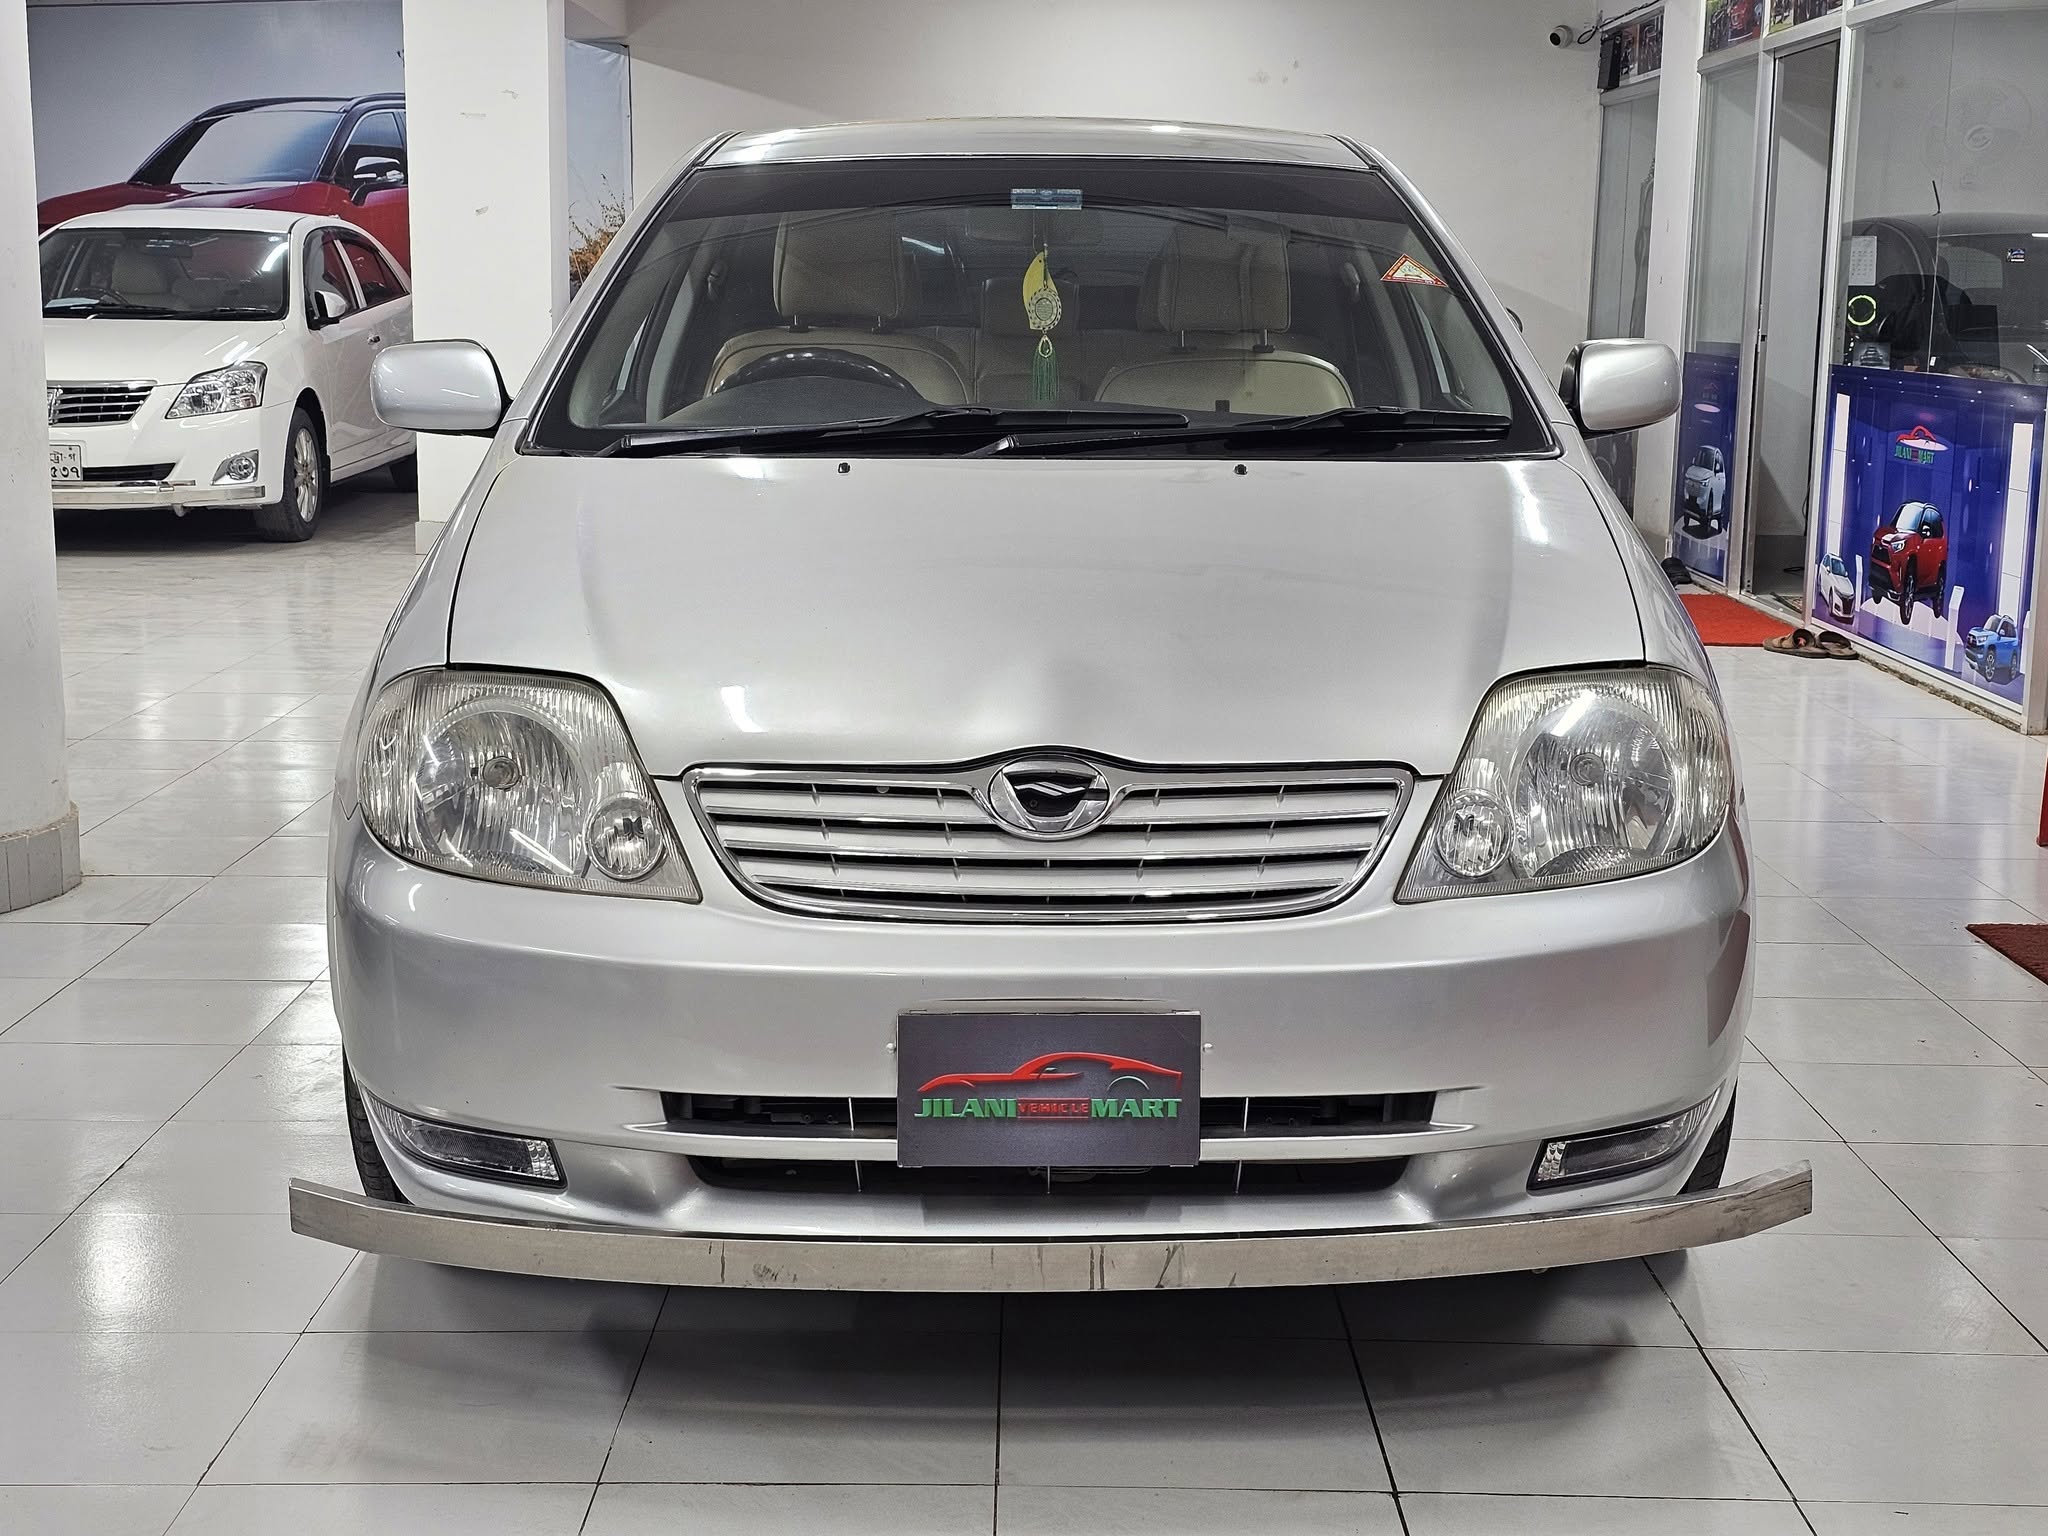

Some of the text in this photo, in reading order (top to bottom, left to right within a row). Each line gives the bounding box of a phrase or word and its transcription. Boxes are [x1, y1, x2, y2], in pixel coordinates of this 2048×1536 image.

[914, 1098, 1183, 1118] JILANI VEHICLE MART
